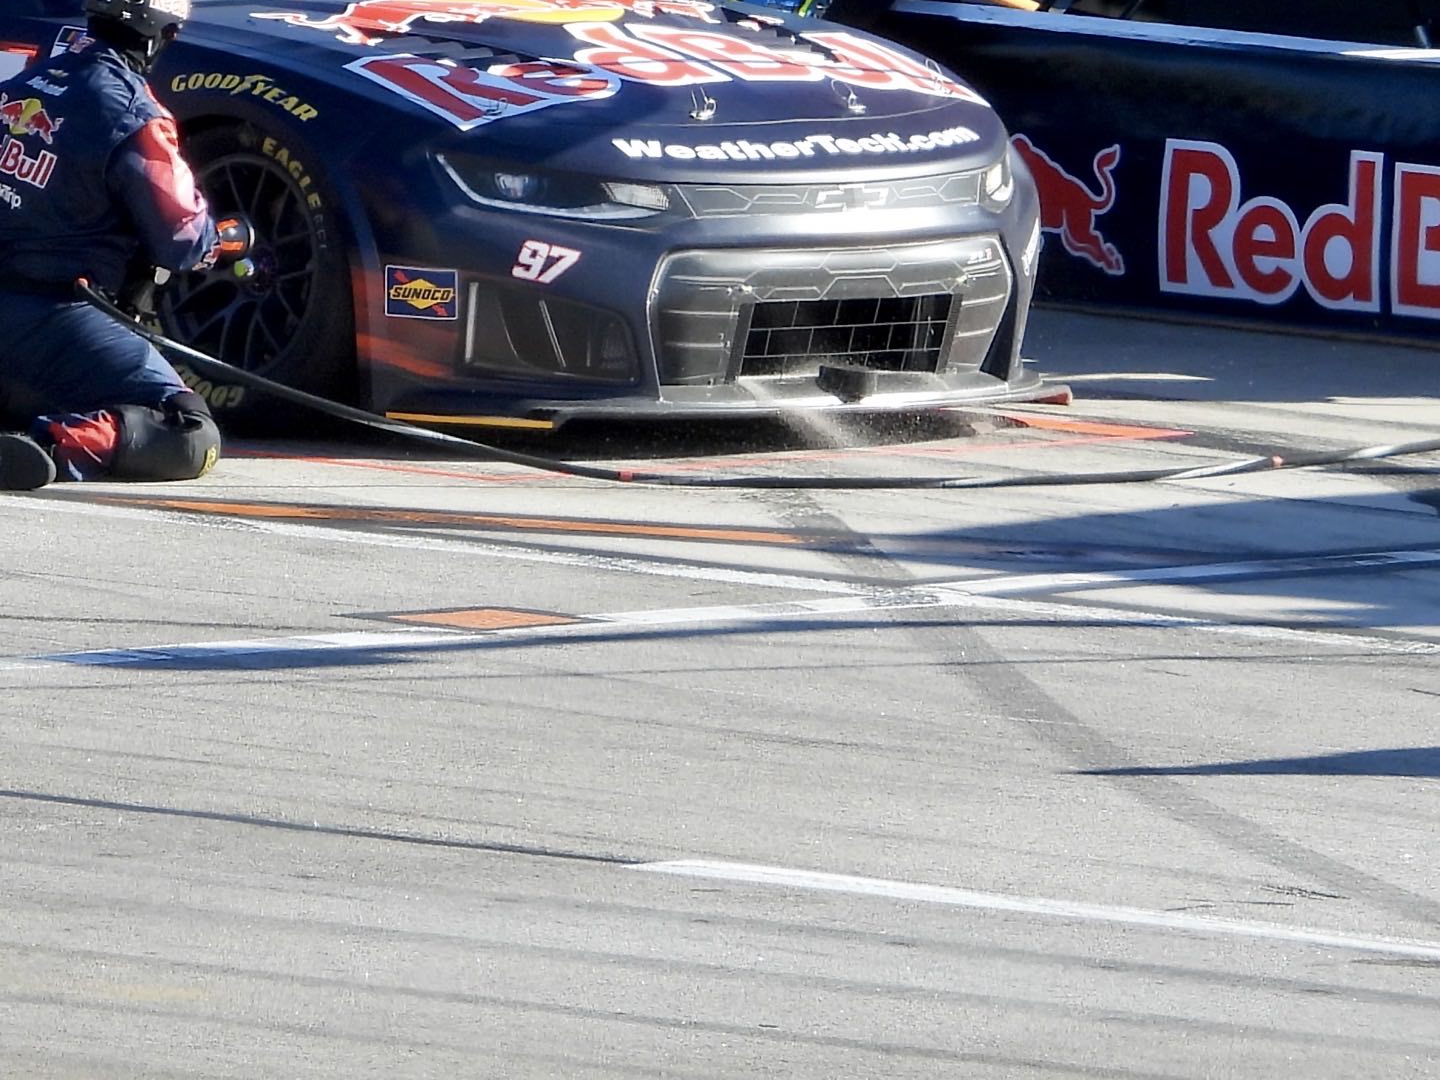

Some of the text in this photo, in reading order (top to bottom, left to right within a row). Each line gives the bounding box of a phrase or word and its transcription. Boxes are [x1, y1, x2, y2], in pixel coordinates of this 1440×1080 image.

[171, 72, 319, 122] GOODYEAR
[612, 126, 980, 161] WeatherTech.com
[262, 135, 322, 210] EAGLE
[1160, 138, 1384, 313] Red
[512, 240, 582, 284] 97
[392, 286, 452, 302] SUNOCO
